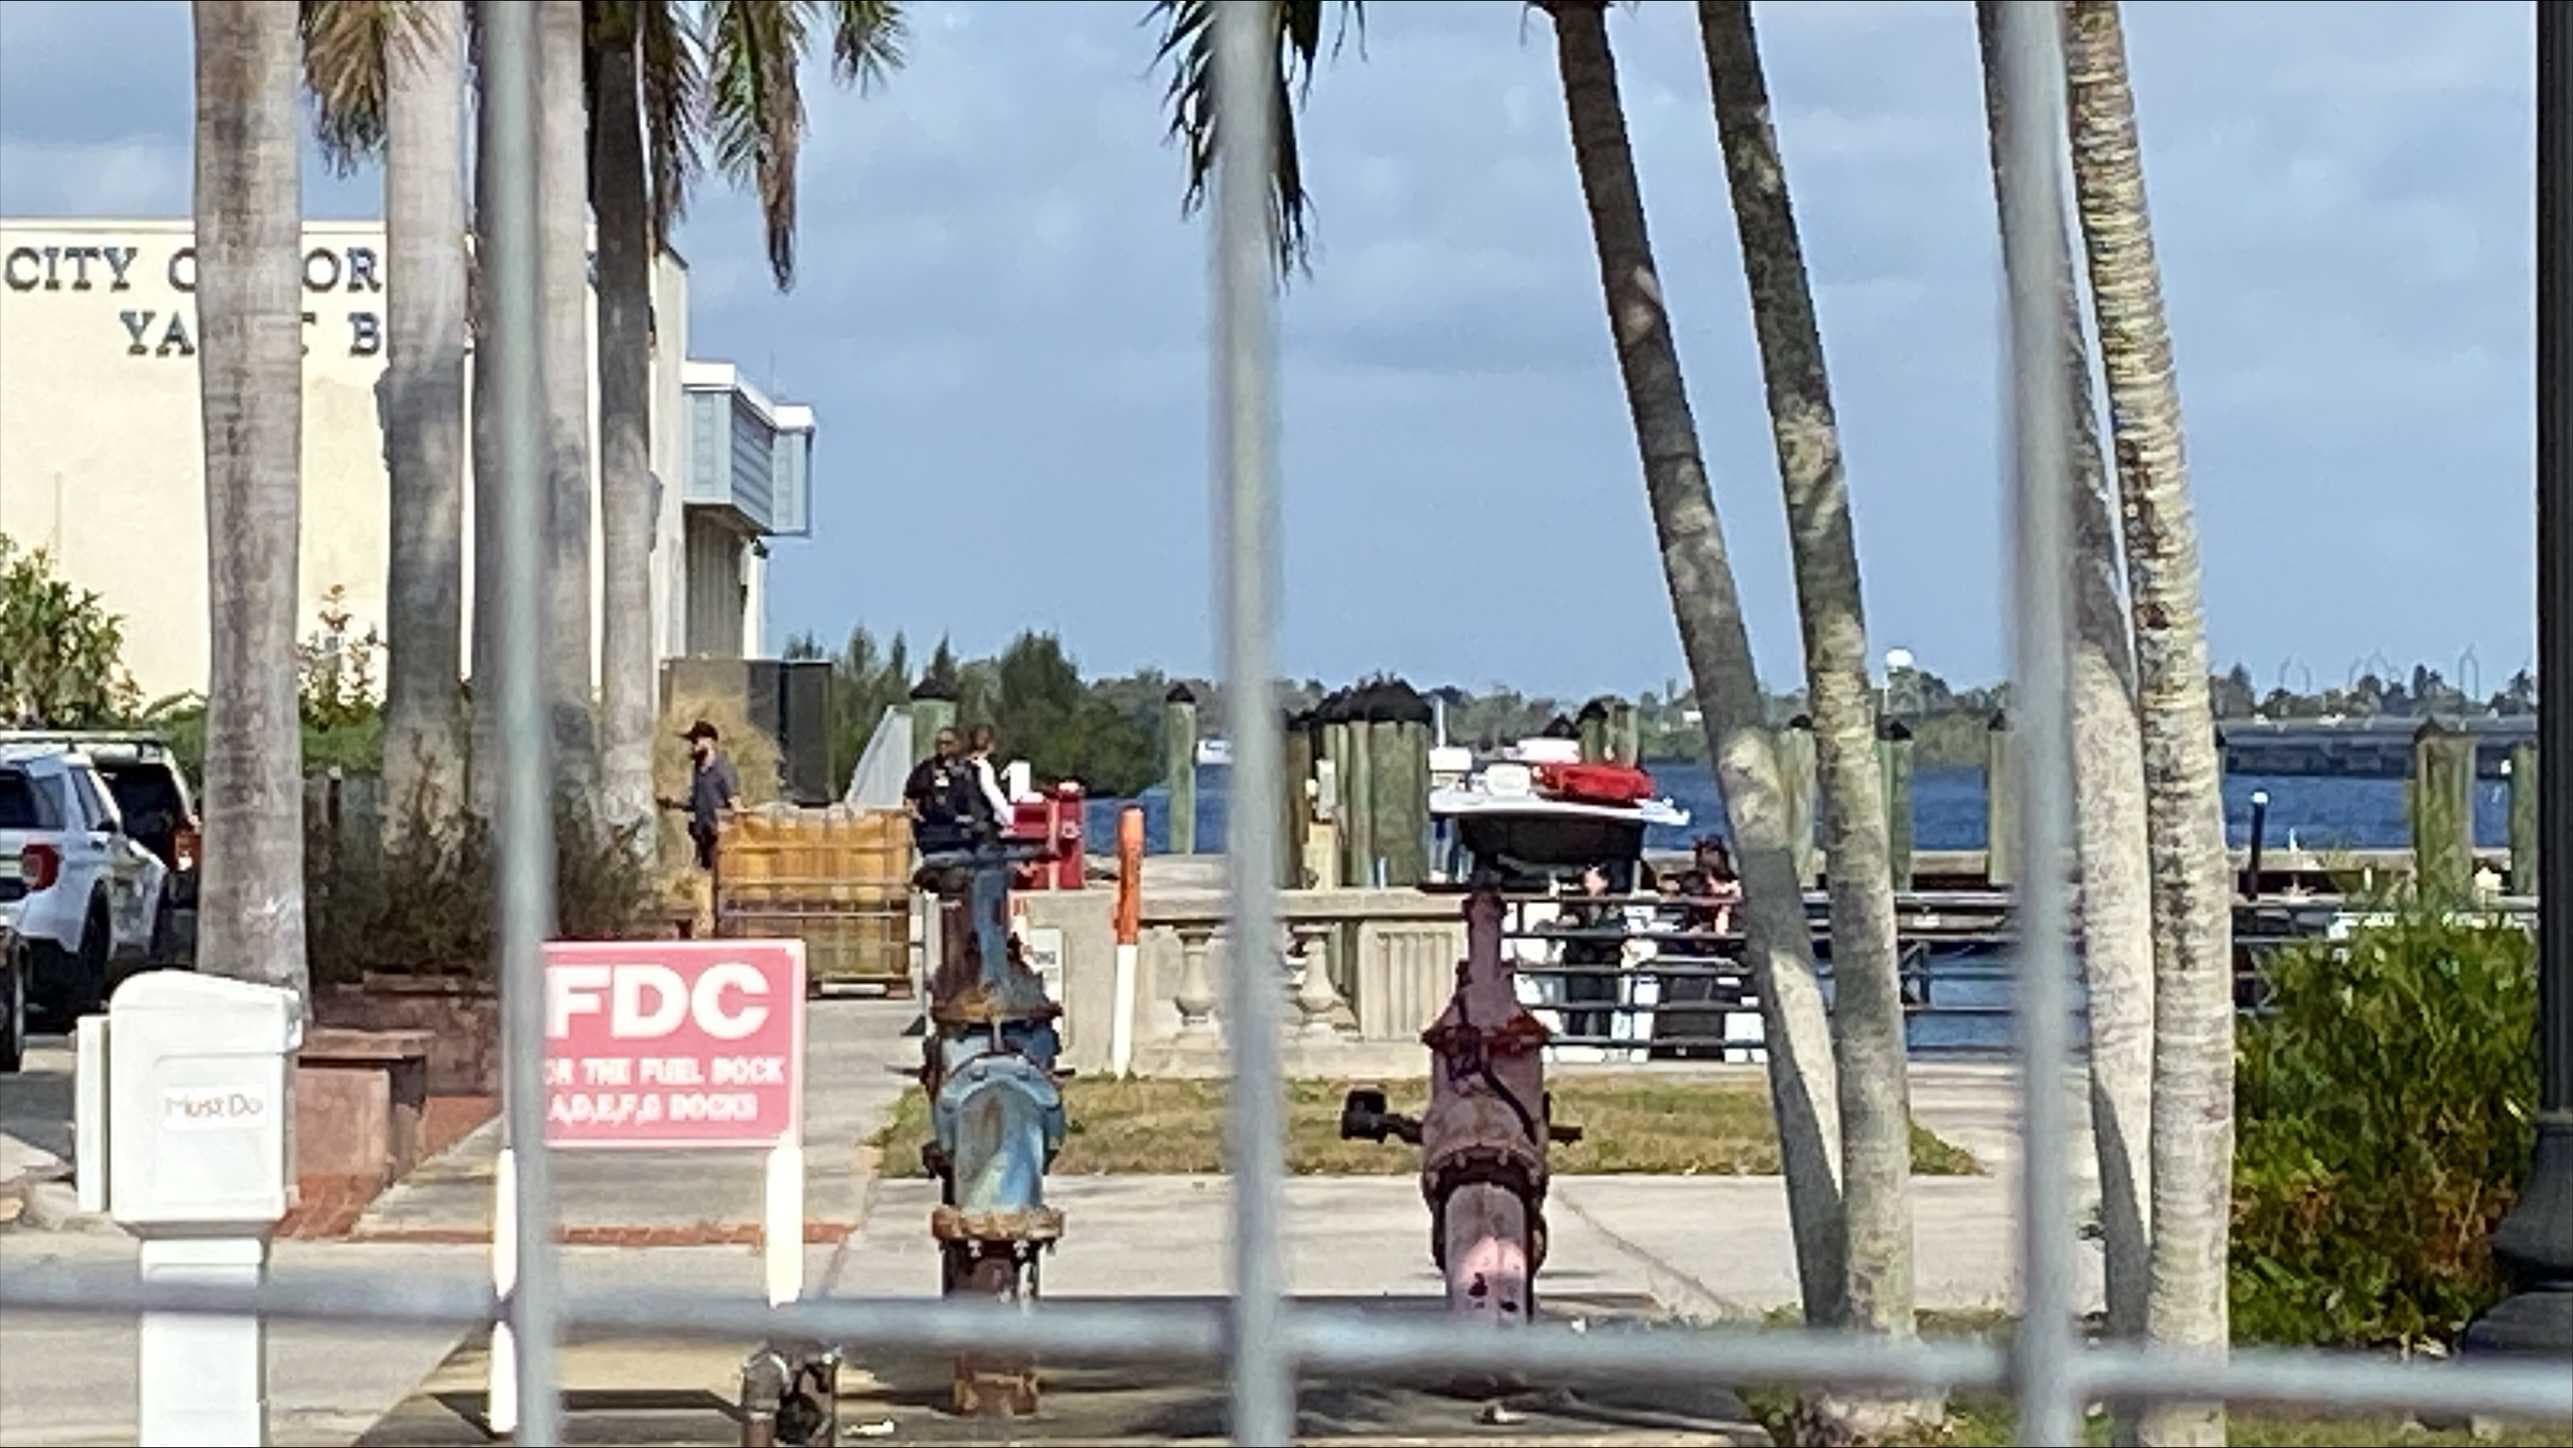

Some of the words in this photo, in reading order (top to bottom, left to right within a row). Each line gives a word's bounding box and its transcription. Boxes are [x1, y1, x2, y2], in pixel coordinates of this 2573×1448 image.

[5, 247, 139, 292] CITY
[168, 247, 197, 292] O
[302, 247, 383, 292] OR
[546, 962, 770, 1040] FDC
[581, 1057, 631, 1086] THE
[639, 1057, 705, 1086] FUEL
[711, 1056, 786, 1086] DOCK
[669, 1093, 758, 1121] DOCKS
